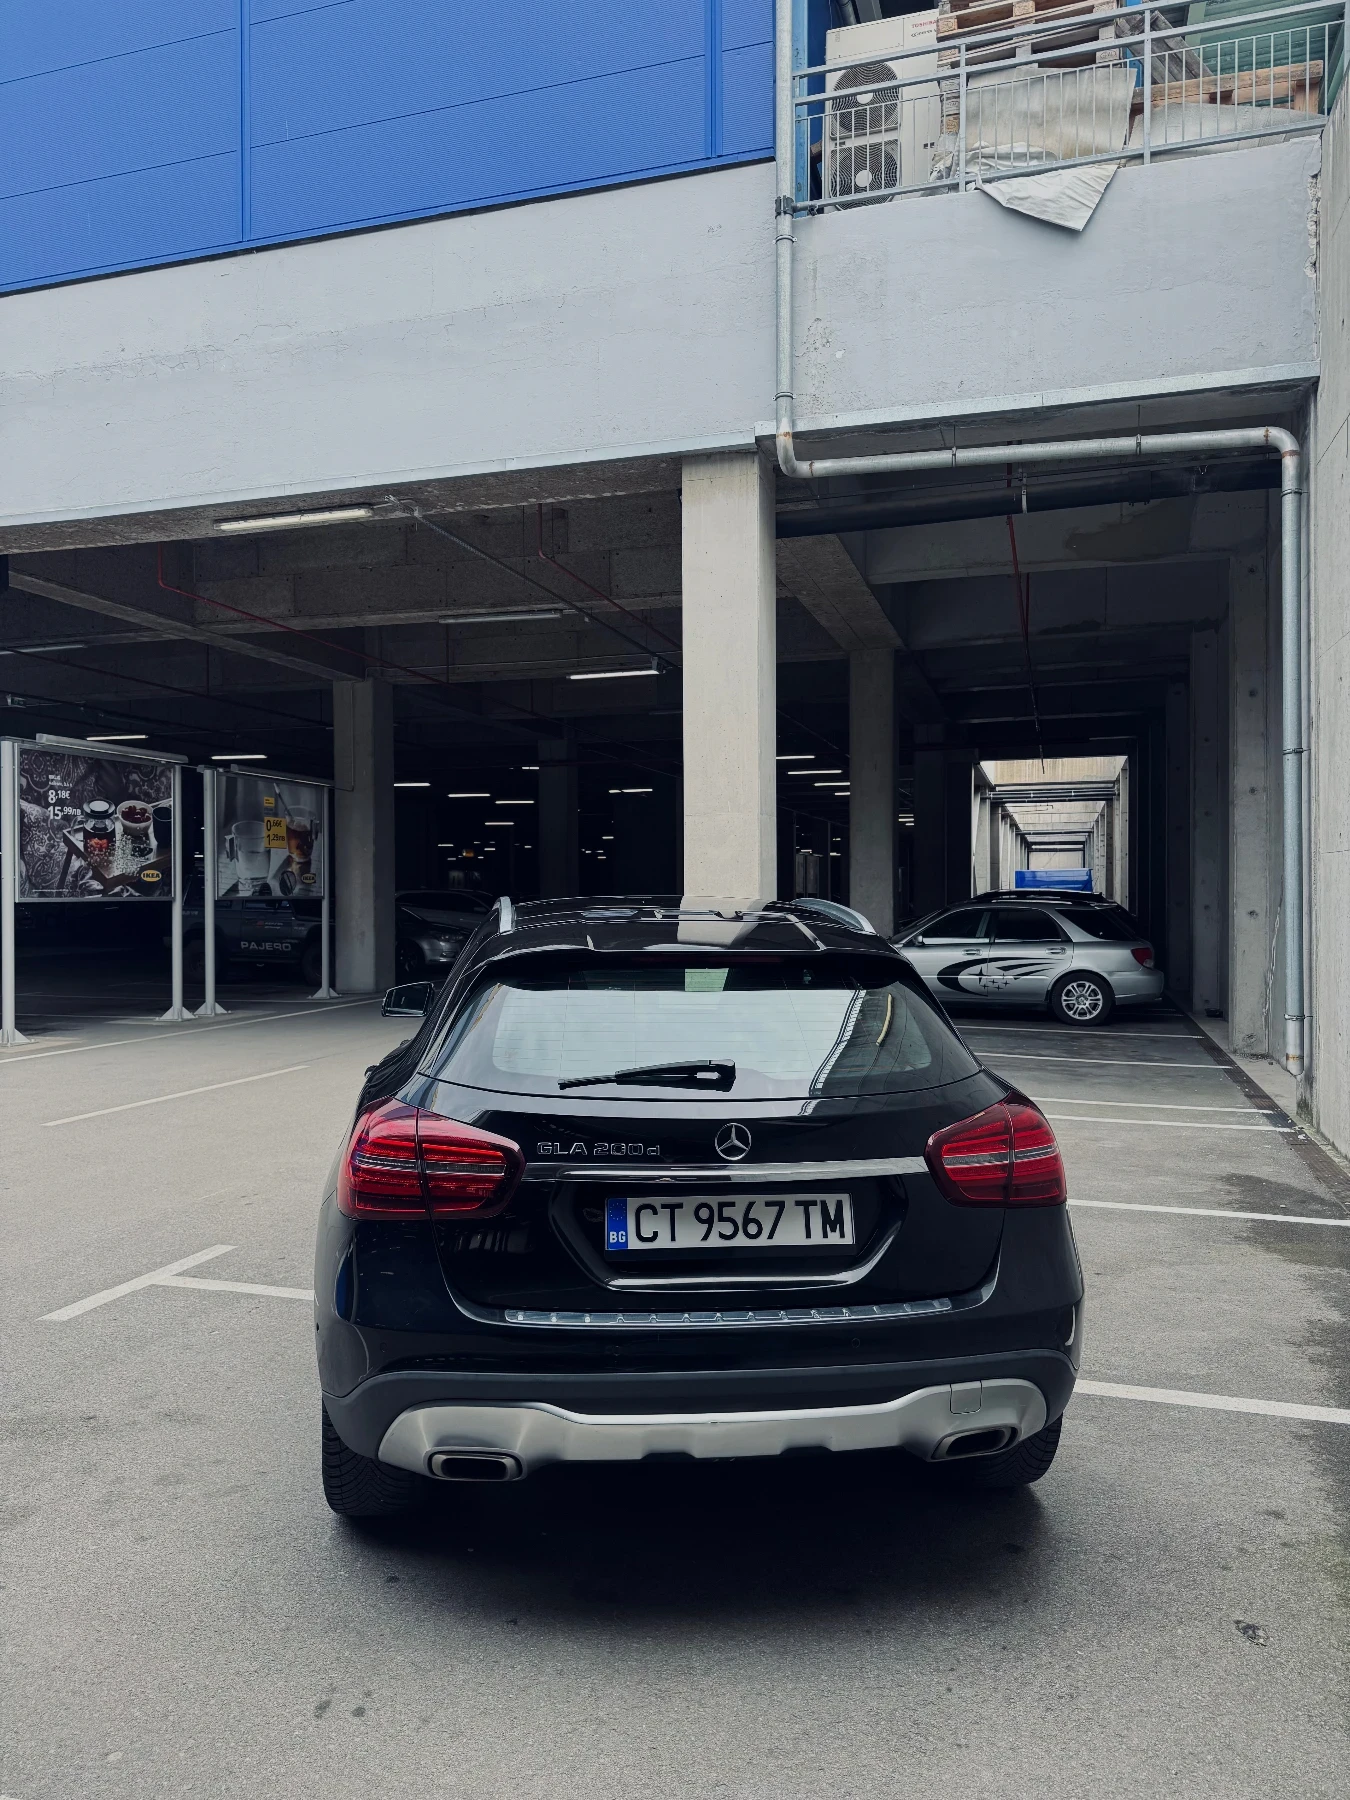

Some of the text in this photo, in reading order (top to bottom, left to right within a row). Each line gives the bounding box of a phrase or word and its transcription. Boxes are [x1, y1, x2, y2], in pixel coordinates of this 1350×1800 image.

[48, 790, 71, 804] 8,18€
[240, 941, 292, 951] PAJERO
[537, 1142, 588, 1155] GLA
[634, 1199, 846, 1243] CT 9567 TM
[609, 1231, 627, 1243] BG
